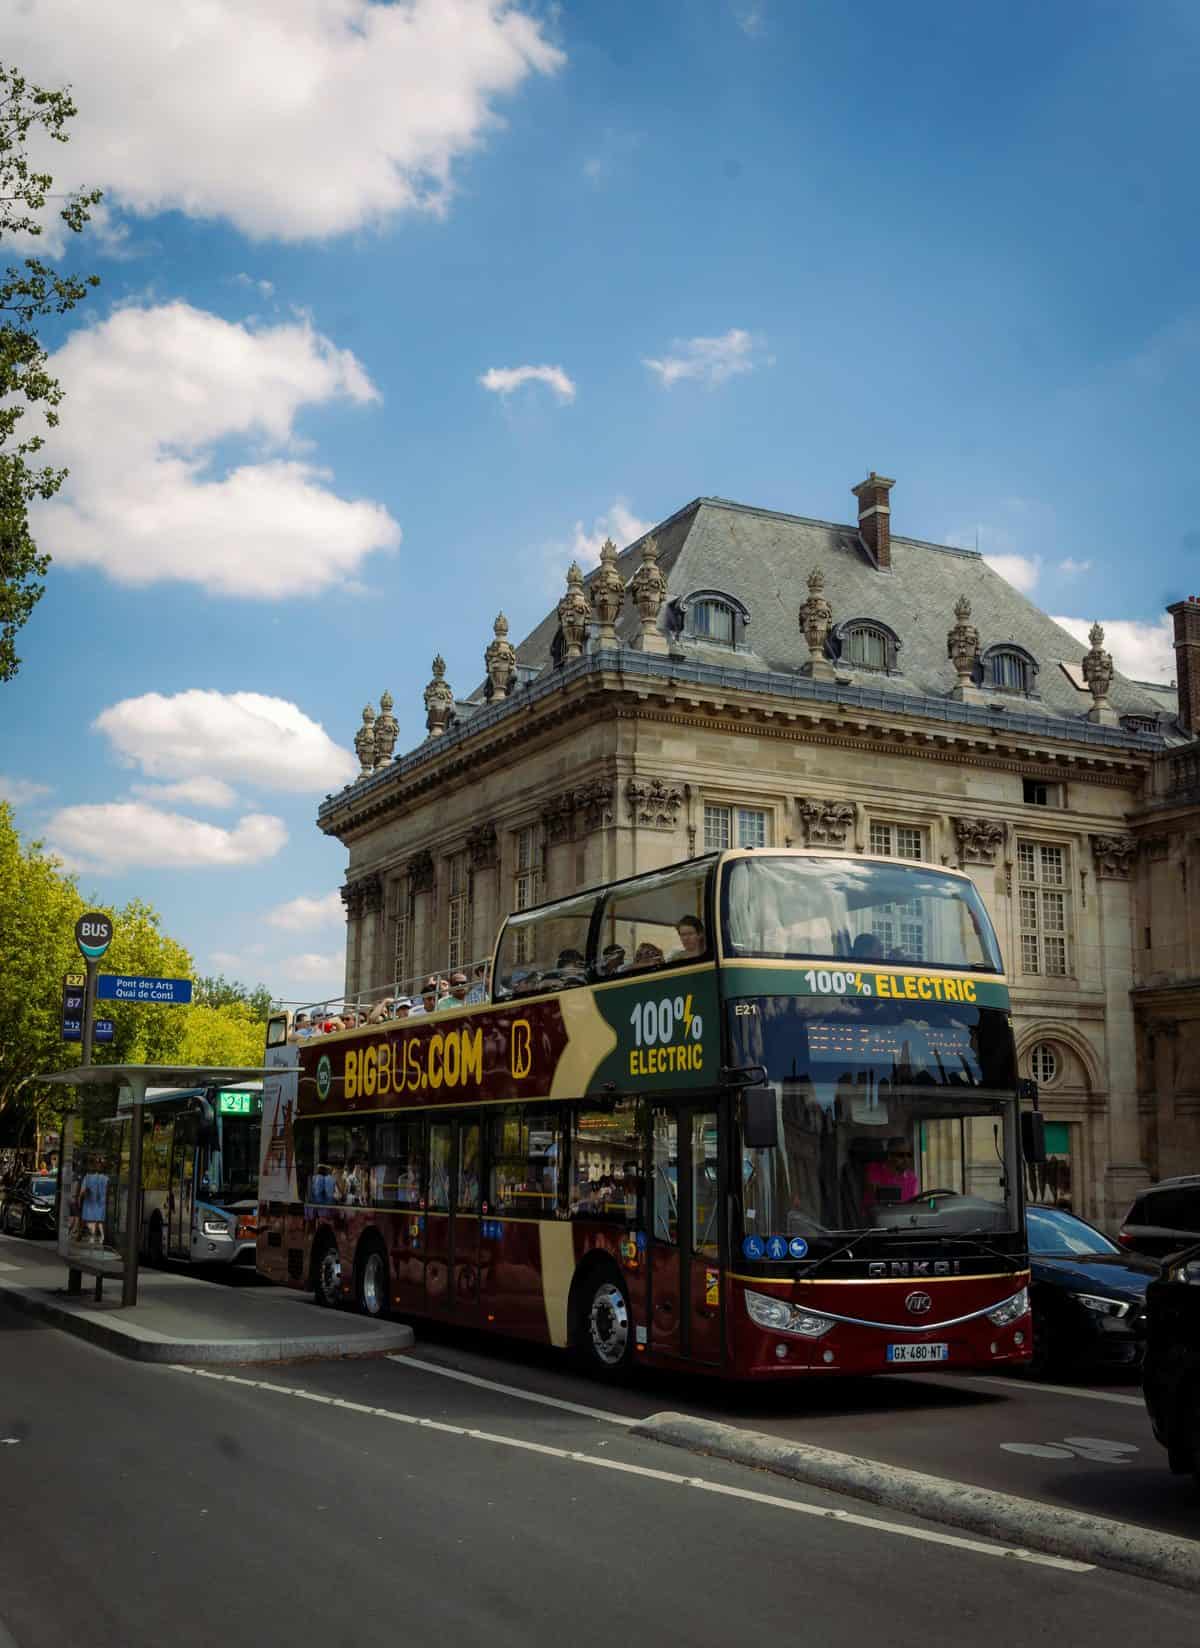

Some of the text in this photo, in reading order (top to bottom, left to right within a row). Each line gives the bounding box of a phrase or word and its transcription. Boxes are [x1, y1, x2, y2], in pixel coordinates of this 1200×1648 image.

[81, 922, 108, 937] BUS
[69, 975, 82, 985] 27
[116, 978, 174, 990] Pont des Arts
[804, 970, 977, 1002] 100% ELECTRIC
[115, 988, 174, 1000] Quai de Conti
[66, 998, 81, 1008] 87
[735, 1004, 756, 1016] E21
[630, 993, 703, 1046] 100%
[344, 1027, 483, 1099] BIGBUS.COM
[630, 1043, 703, 1076] ELECTRIC
